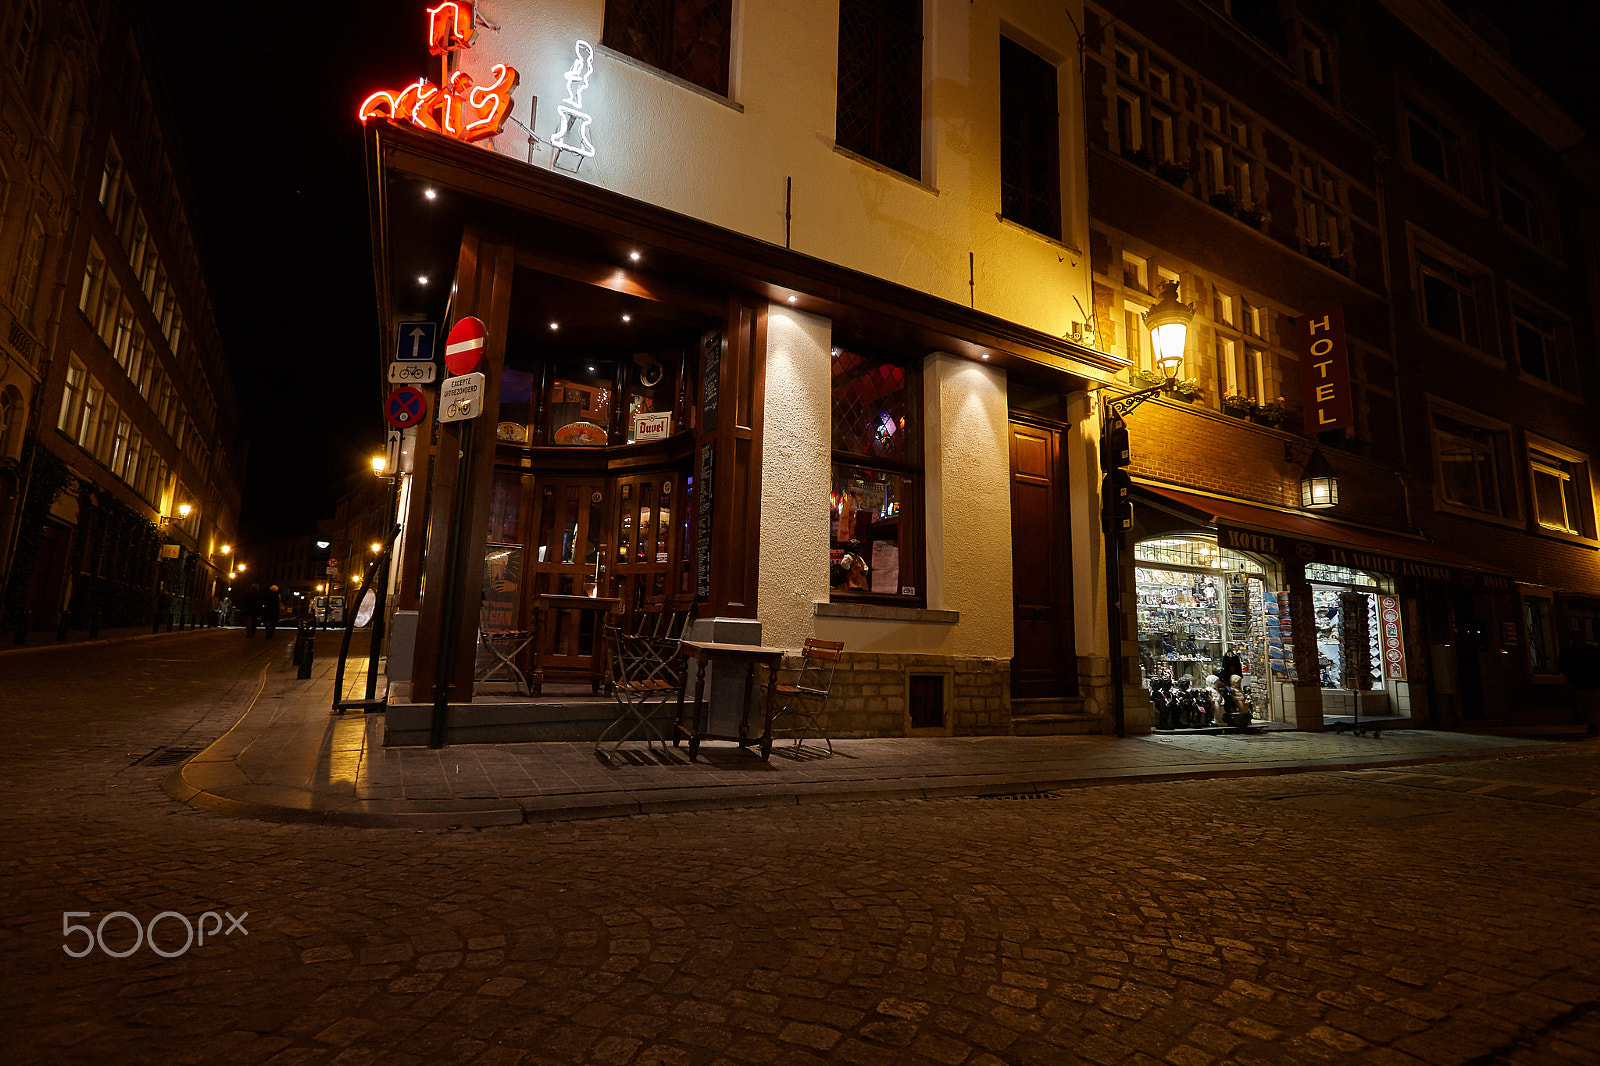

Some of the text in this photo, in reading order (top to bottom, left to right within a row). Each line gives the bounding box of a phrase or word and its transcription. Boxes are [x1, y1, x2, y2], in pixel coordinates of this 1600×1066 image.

[1308, 314, 1337, 425] HOTEL
[640, 420, 665, 434] Duvel
[1227, 530, 1278, 554] HOTEL
[1331, 549, 1347, 565] LA
